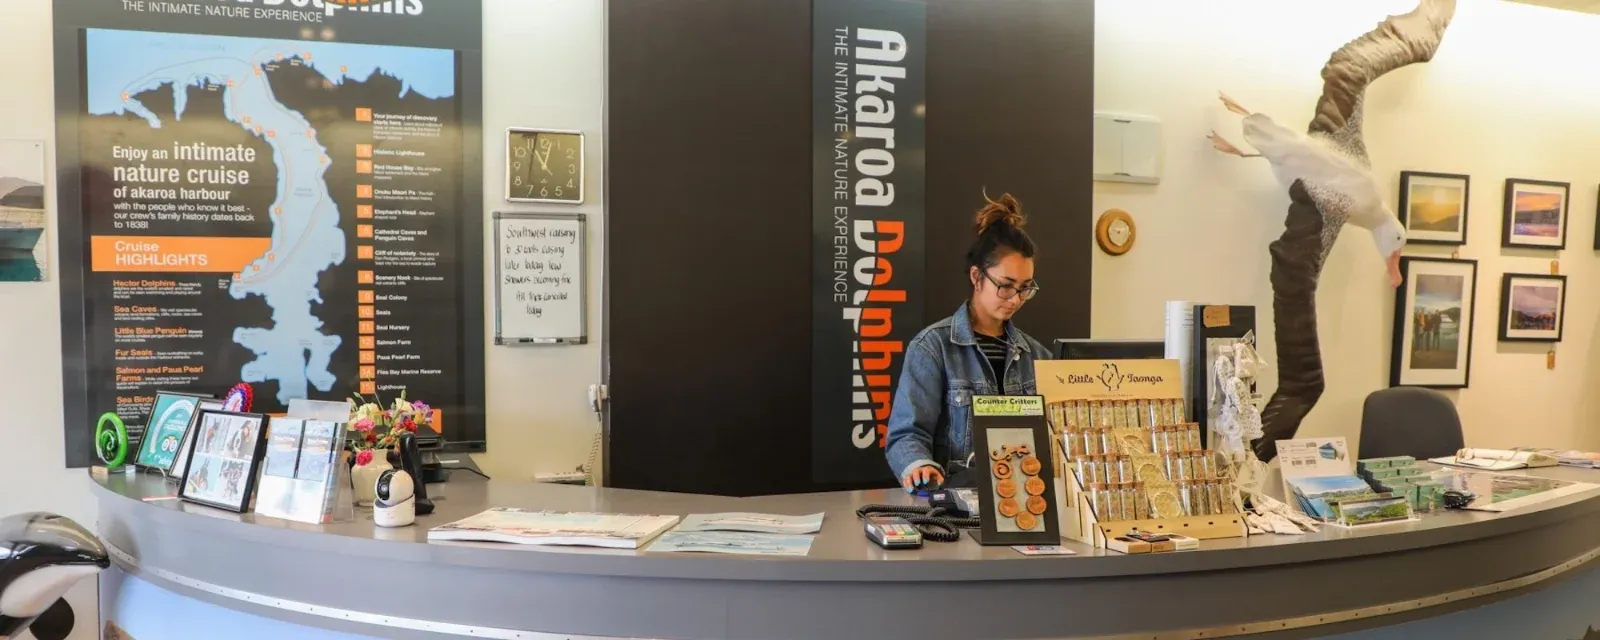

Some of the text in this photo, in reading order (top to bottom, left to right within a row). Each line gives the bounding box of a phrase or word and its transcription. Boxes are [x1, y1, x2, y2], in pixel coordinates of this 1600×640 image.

[122, 0, 144, 12] THE
[149, 1, 202, 15] INTIMATE
[205, 5, 250, 18] NATURE
[254, 8, 322, 23] EXPERIENCE
[540, 138, 550, 149] 12
[113, 141, 256, 162] Enjoy an intimate
[396, 149, 425, 157] Lighthouse
[513, 146, 526, 158] 10
[566, 147, 574, 159] 2
[513, 161, 521, 171] 9
[568, 163, 576, 174] 3
[834, 26, 849, 302] THE INTIMATE NATURE EXPERIENCE
[113, 164, 249, 184] nature cruise
[514, 175, 522, 186] 8
[566, 178, 574, 188] 4
[113, 186, 230, 200] of akaroa harbour
[526, 184, 534, 197] 7
[540, 186, 548, 197] 6
[555, 185, 562, 196] 5
[114, 202, 131, 210] with
[133, 202, 146, 210] the
[148, 203, 176, 212] people
[178, 203, 195, 211] who
[197, 203, 219, 212] know
[220, 204, 226, 212] it
[227, 204, 245, 212] best
[130, 212, 156, 220] crew's
[157, 212, 181, 222] family
[182, 212, 209, 222] history
[211, 213, 233, 221] dates
[235, 213, 254, 222] back
[126, 221, 148, 229] 1838!
[843, 27, 907, 450] Akaroa Dolphins
[115, 240, 159, 252] Cruise
[115, 253, 208, 266] HIGHLIGHTS
[141, 279, 176, 288] Dolphins
[155, 326, 187, 335] Penguin
[116, 366, 145, 374] Salmon
[184, 365, 204, 373] Pearl
[1067, 374, 1095, 384] Little
[976, 397, 1038, 405] Counter Critters
